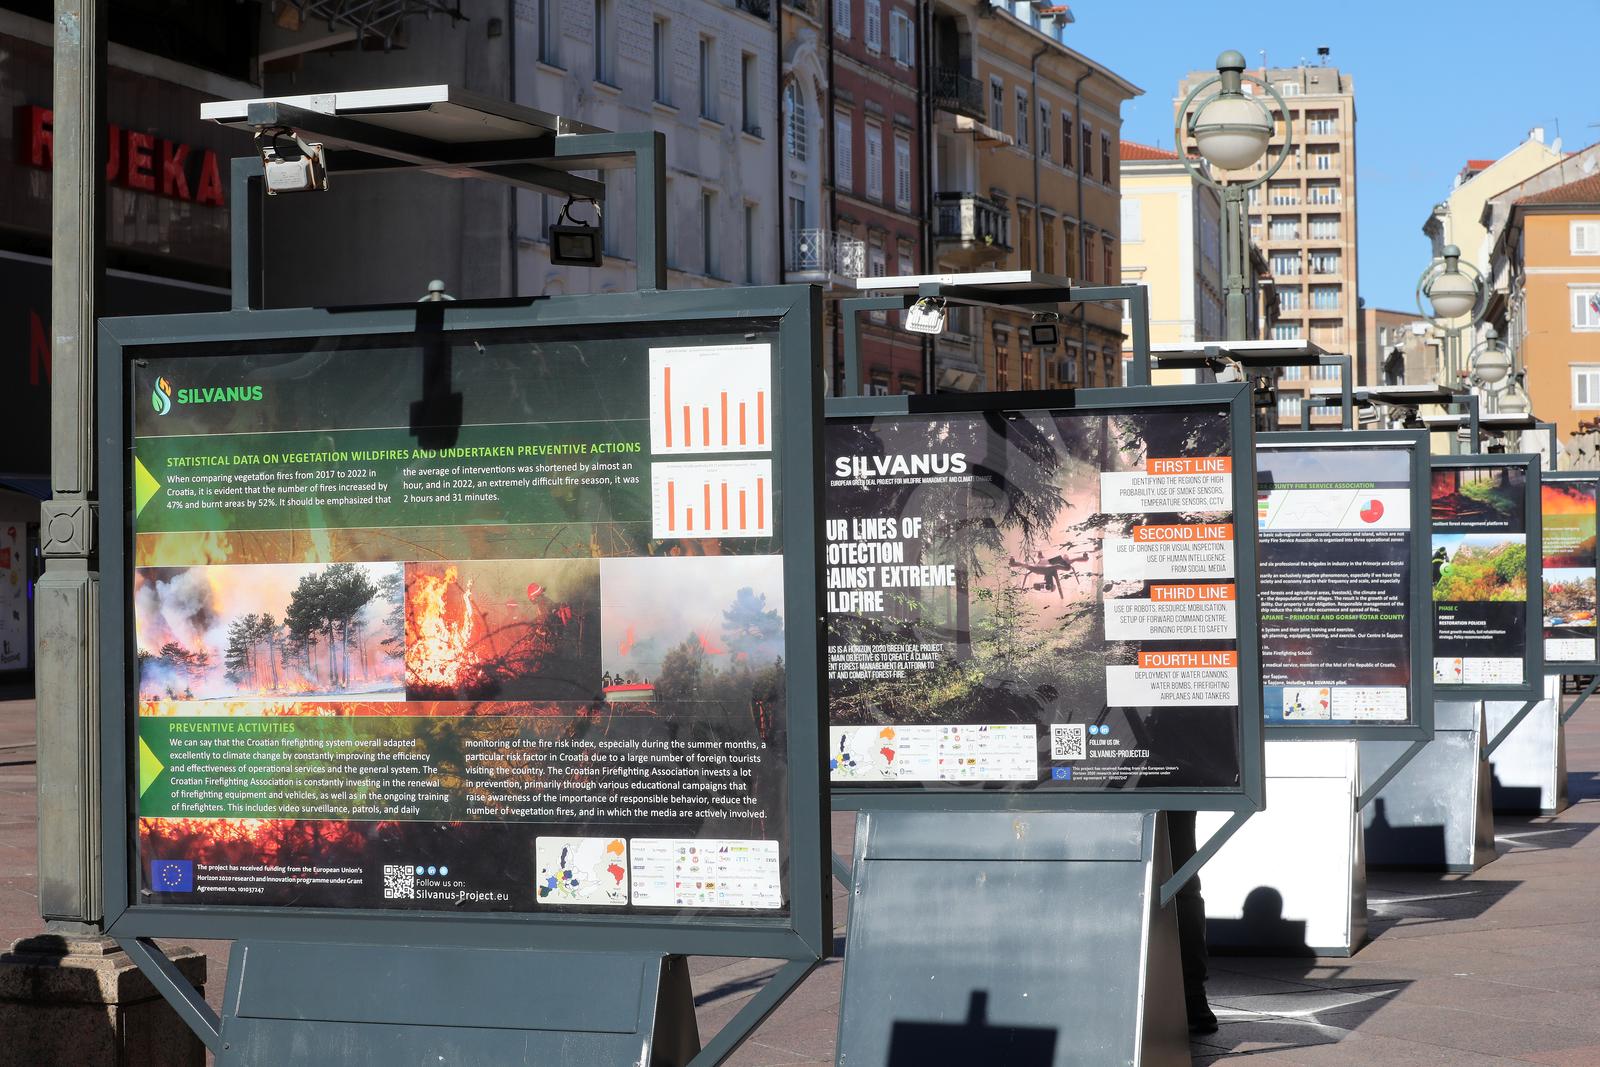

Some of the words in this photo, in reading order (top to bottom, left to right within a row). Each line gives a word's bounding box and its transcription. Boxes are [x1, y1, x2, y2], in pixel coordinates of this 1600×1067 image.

[27, 104, 224, 206] RJEKA
[177, 386, 263, 404] SILVANUS
[167, 456, 230, 467] STATISTICAL
[233, 455, 260, 465] DATA
[263, 454, 279, 464] ON
[282, 452, 348, 463] VEGETATION
[351, 449, 409, 461] WILDFIRES
[412, 449, 436, 459] AND
[440, 446, 514, 458] UNDERTAKEN
[518, 444, 586, 456] PREVENTIVE
[590, 442, 641, 454] ACTIONS
[403, 467, 416, 476] the
[418, 468, 449, 477] average
[451, 466, 460, 475] of
[462, 464, 515, 474] interventions
[535, 463, 577, 472] shortened
[579, 462, 589, 472] by
[591, 461, 620, 470] almost
[835, 453, 967, 477] SILVANUS
[1154, 460, 1191, 472] FIRST
[1195, 459, 1225, 471] LINE
[166, 474, 189, 483] When
[191, 473, 232, 484] comparing
[233, 472, 274, 483] vegetation
[276, 471, 293, 480] fires
[294, 470, 313, 479] from
[314, 470, 335, 479] 2017
[336, 470, 345, 478] to
[347, 469, 366, 478] 2022
[368, 469, 376, 477] in
[402, 480, 423, 490] hour,
[425, 480, 440, 489] and
[442, 480, 450, 488] in
[452, 479, 475, 488] 2022,
[489, 478, 530, 489] extremely
[531, 477, 563, 486] difficult
[564, 477, 579, 485] fire
[614, 476, 620, 484] it
[166, 487, 197, 496] Croatia,
[198, 487, 204, 495] it
[206, 486, 212, 495] is
[214, 486, 242, 495] evident
[244, 485, 260, 494] that
[262, 485, 275, 494] the
[277, 484, 306, 493] number
[309, 484, 318, 492] of
[319, 483, 336, 492] fires
[338, 482, 376, 491] increased
[378, 482, 387, 492] by
[166, 500, 183, 509] 47%
[185, 500, 199, 509] and
[201, 499, 222, 508] burnt
[246, 499, 256, 509] by
[258, 498, 277, 507] 52%.
[279, 498, 285, 506] It
[287, 497, 312, 506] should
[314, 497, 324, 506] be
[326, 496, 373, 507] emphasized
[375, 496, 391, 504] that
[403, 494, 408, 503] 2
[410, 494, 433, 502] hours
[434, 493, 450, 502] and
[452, 493, 462, 502] 31
[464, 493, 499, 502] minutes.
[826, 519, 848, 540] UR
[852, 518, 897, 539] LINES
[902, 517, 921, 538] OF
[1140, 528, 1192, 540] SECOND
[1196, 527, 1226, 538] LINE
[827, 542, 904, 564] OTECTION
[827, 567, 876, 588] AINST
[881, 565, 956, 587] EXTREME
[1155, 587, 1195, 599] THIRD
[1199, 586, 1228, 599] LINE
[827, 590, 884, 612] ILDFIRE
[1144, 654, 1198, 666] FOURTH
[1202, 654, 1230, 665] LINE
[169, 723, 234, 732] PREVENTIVE
[237, 723, 295, 732] ACTIVITIES
[169, 738, 182, 746] We
[214, 738, 229, 746] that
[232, 738, 244, 747] the
[246, 738, 279, 747] Croatian
[281, 738, 323, 748] firefighting
[325, 738, 352, 748] system
[354, 738, 381, 747] overall
[383, 738, 416, 749] adapted
[1090, 749, 1150, 758] SILVANUS-PROJECT.EU
[416, 878, 440, 886] Follow
[416, 889, 509, 901] Silvanus-Project.eu
